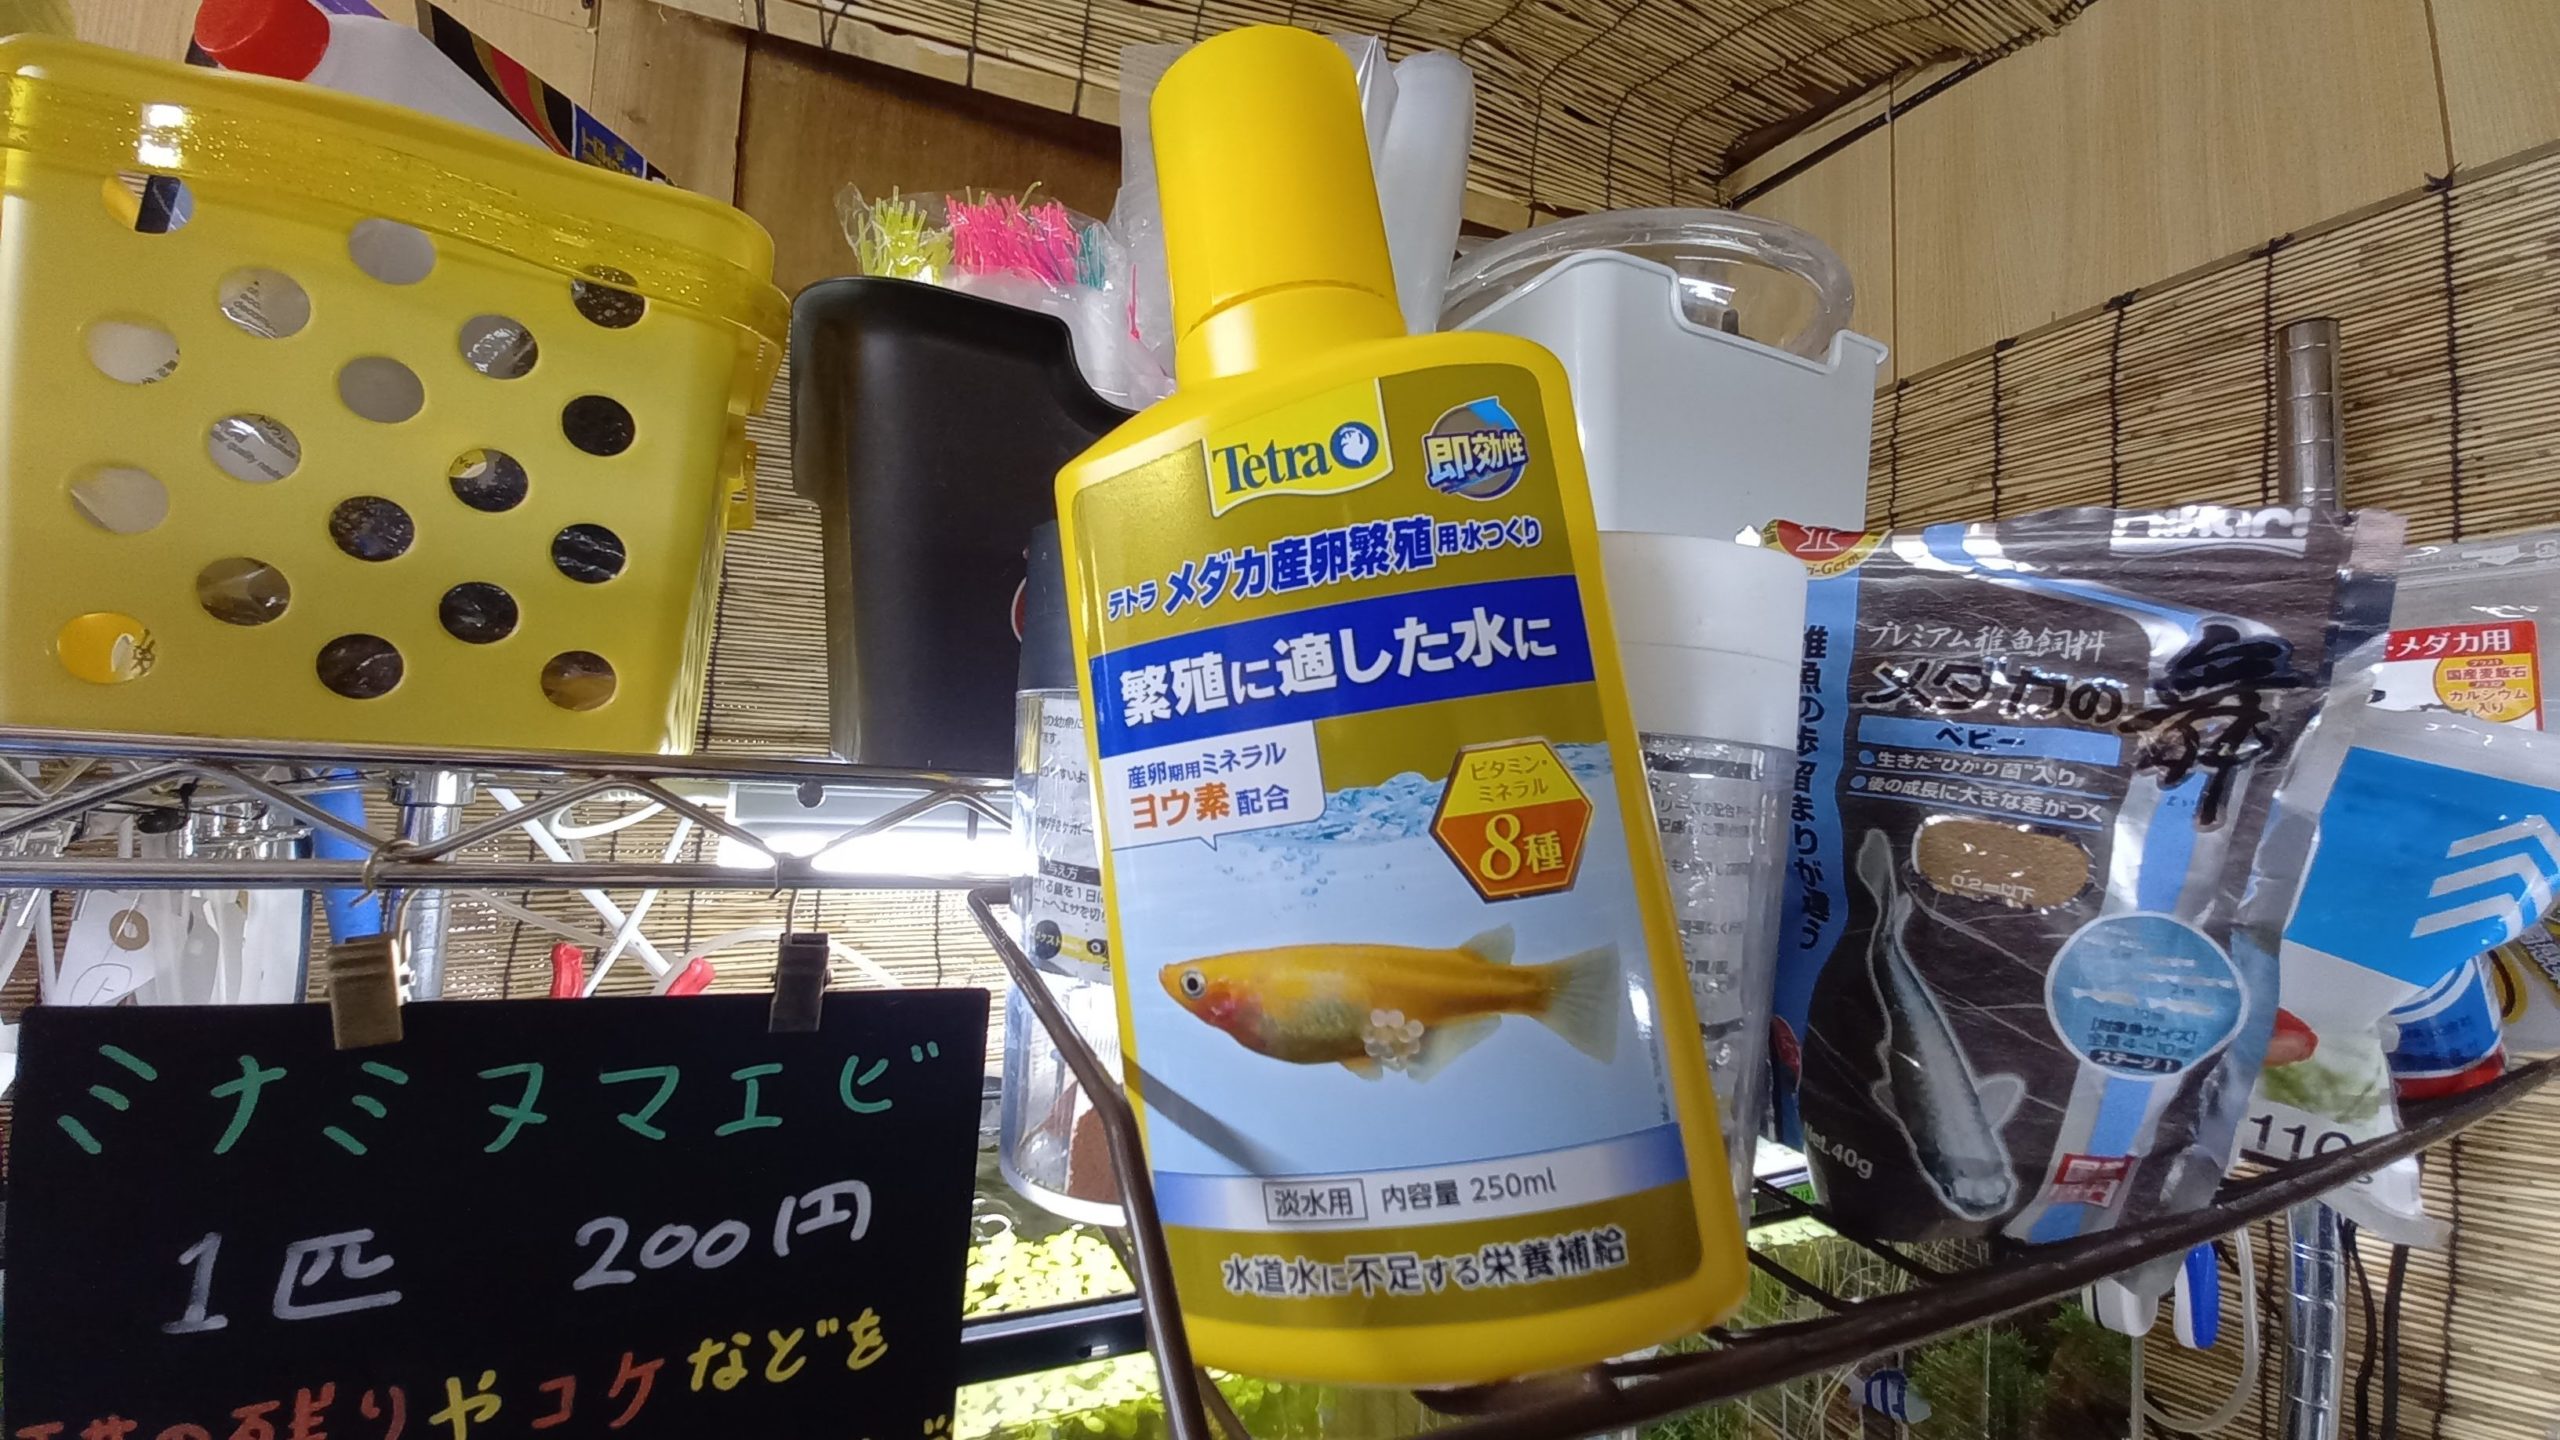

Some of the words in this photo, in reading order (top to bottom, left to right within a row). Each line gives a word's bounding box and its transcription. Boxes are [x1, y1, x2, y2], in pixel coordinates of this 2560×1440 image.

[1211, 439, 1331, 493] Tetra
[1426, 429, 1527, 484] 即効性
[1119, 606, 1558, 728] 繁殖に適した水に
[1867, 620, 2107, 663] プレミアム稚魚飼料
[2445, 666, 2527, 681] 国産麦飯石
[2449, 688, 2529, 702] カルシウム
[1935, 727, 2026, 751] ベビー
[1127, 741, 1287, 790] 産卵期用ミネラル
[1478, 780, 1549, 804] ミネラル
[1867, 776, 2104, 824] 後の成長に大きな差がつく
[1478, 813, 1566, 881] 8種
[57, 1038, 940, 1155] ミナミヌマエビ
[1274, 1187, 1355, 1218] 淡水用
[1381, 1179, 1462, 1214] 内容量
[1471, 1166, 1557, 1203] 250ml
[573, 1178, 871, 1291] 200円
[1222, 1227, 1628, 1296] 水道水に不足する栄養補給
